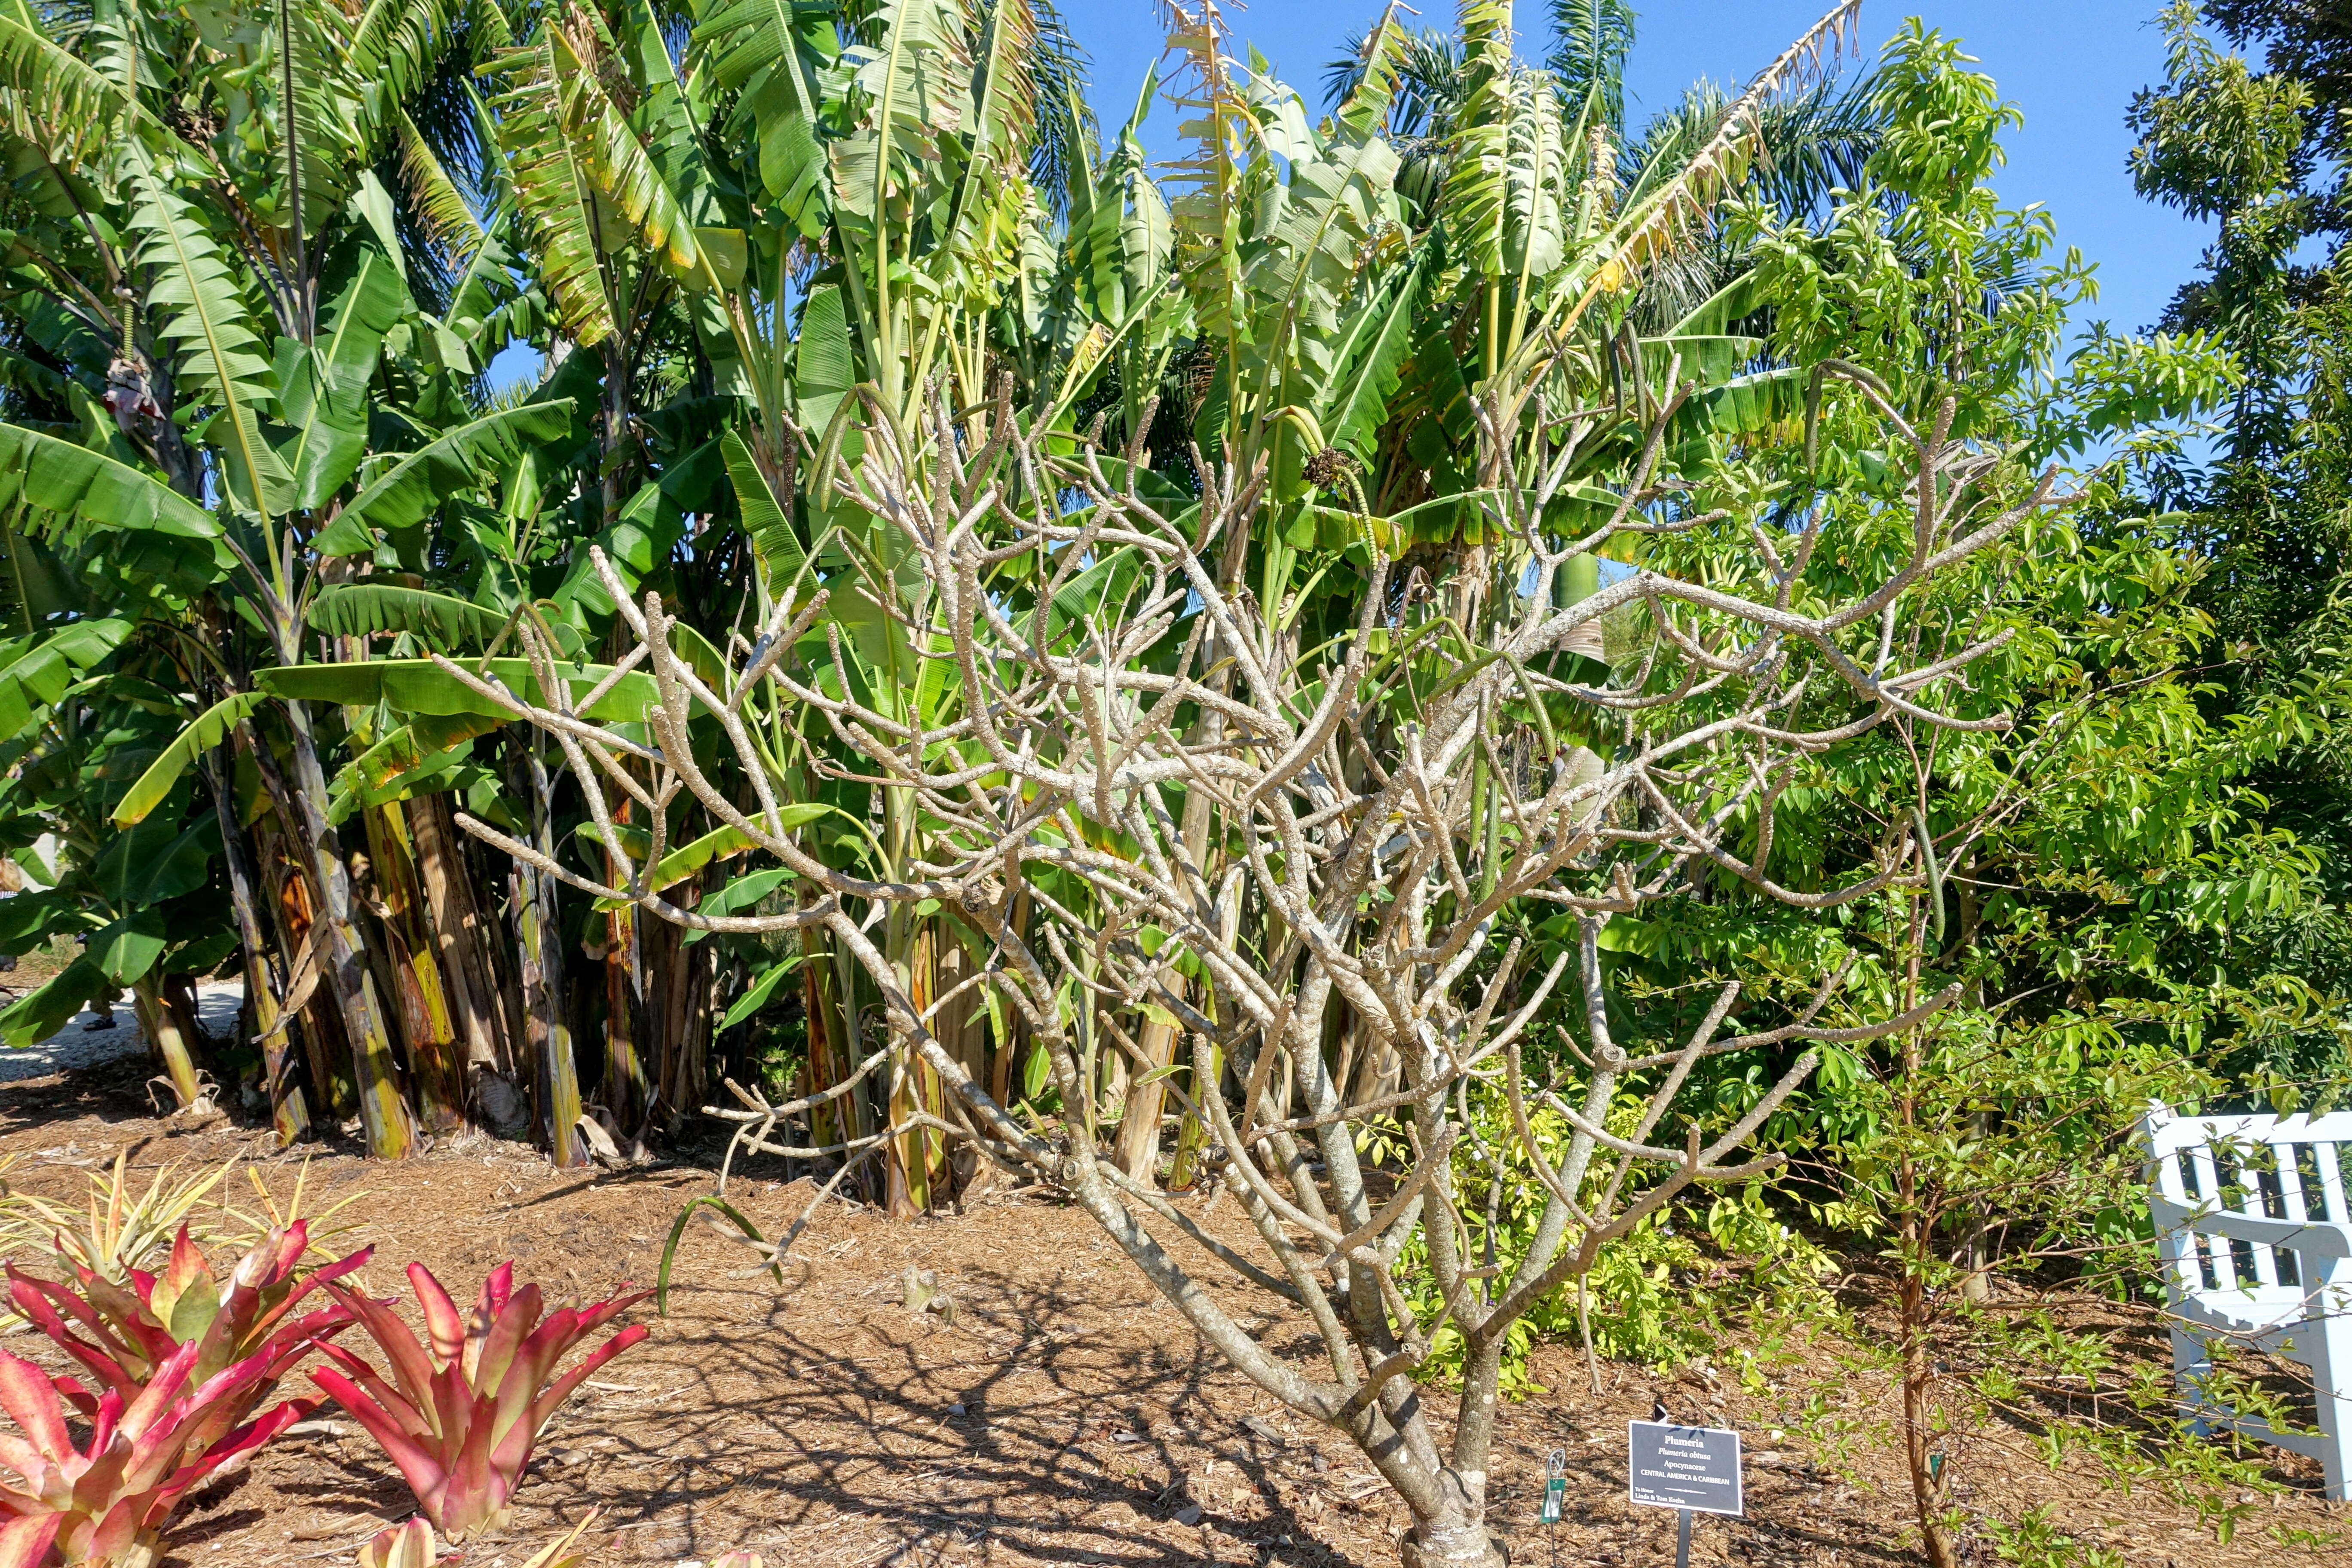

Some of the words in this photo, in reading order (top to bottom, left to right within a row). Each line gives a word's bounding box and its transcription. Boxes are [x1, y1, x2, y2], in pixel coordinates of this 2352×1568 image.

[1665, 1435, 1704, 1448] Plumeria
[1658, 1447, 1687, 1458] Plumeria
[1689, 1451, 1711, 1460] obtusa
[1664, 1460, 1706, 1471] Apocynaceae
[1641, 1469, 1666, 1478] CENTRAL
[1667, 1472, 1692, 1481] AMERICA
[1698, 1476, 1730, 1485] CARIBBEAN
